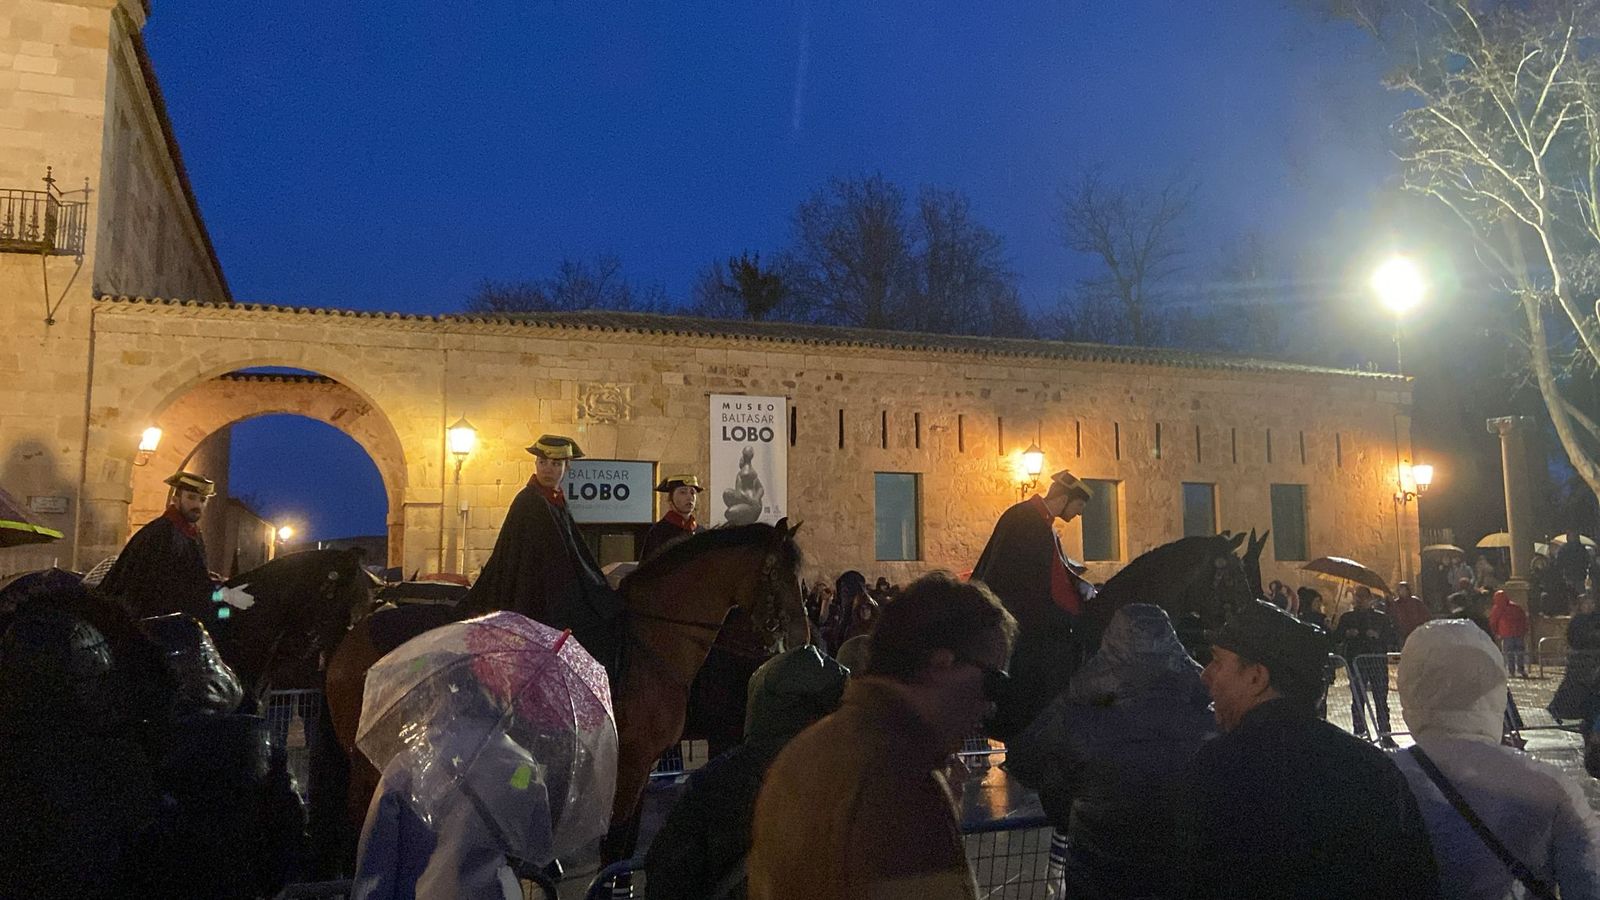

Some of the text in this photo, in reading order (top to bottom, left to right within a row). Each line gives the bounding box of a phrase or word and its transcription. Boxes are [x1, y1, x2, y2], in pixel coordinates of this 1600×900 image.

[722, 402, 774, 411] MUSEO
[722, 413, 774, 424] BALTASAR
[722, 426, 774, 443] LOBO
[568, 468, 629, 480] BALTASAR
[568, 482, 630, 501] LOBO
